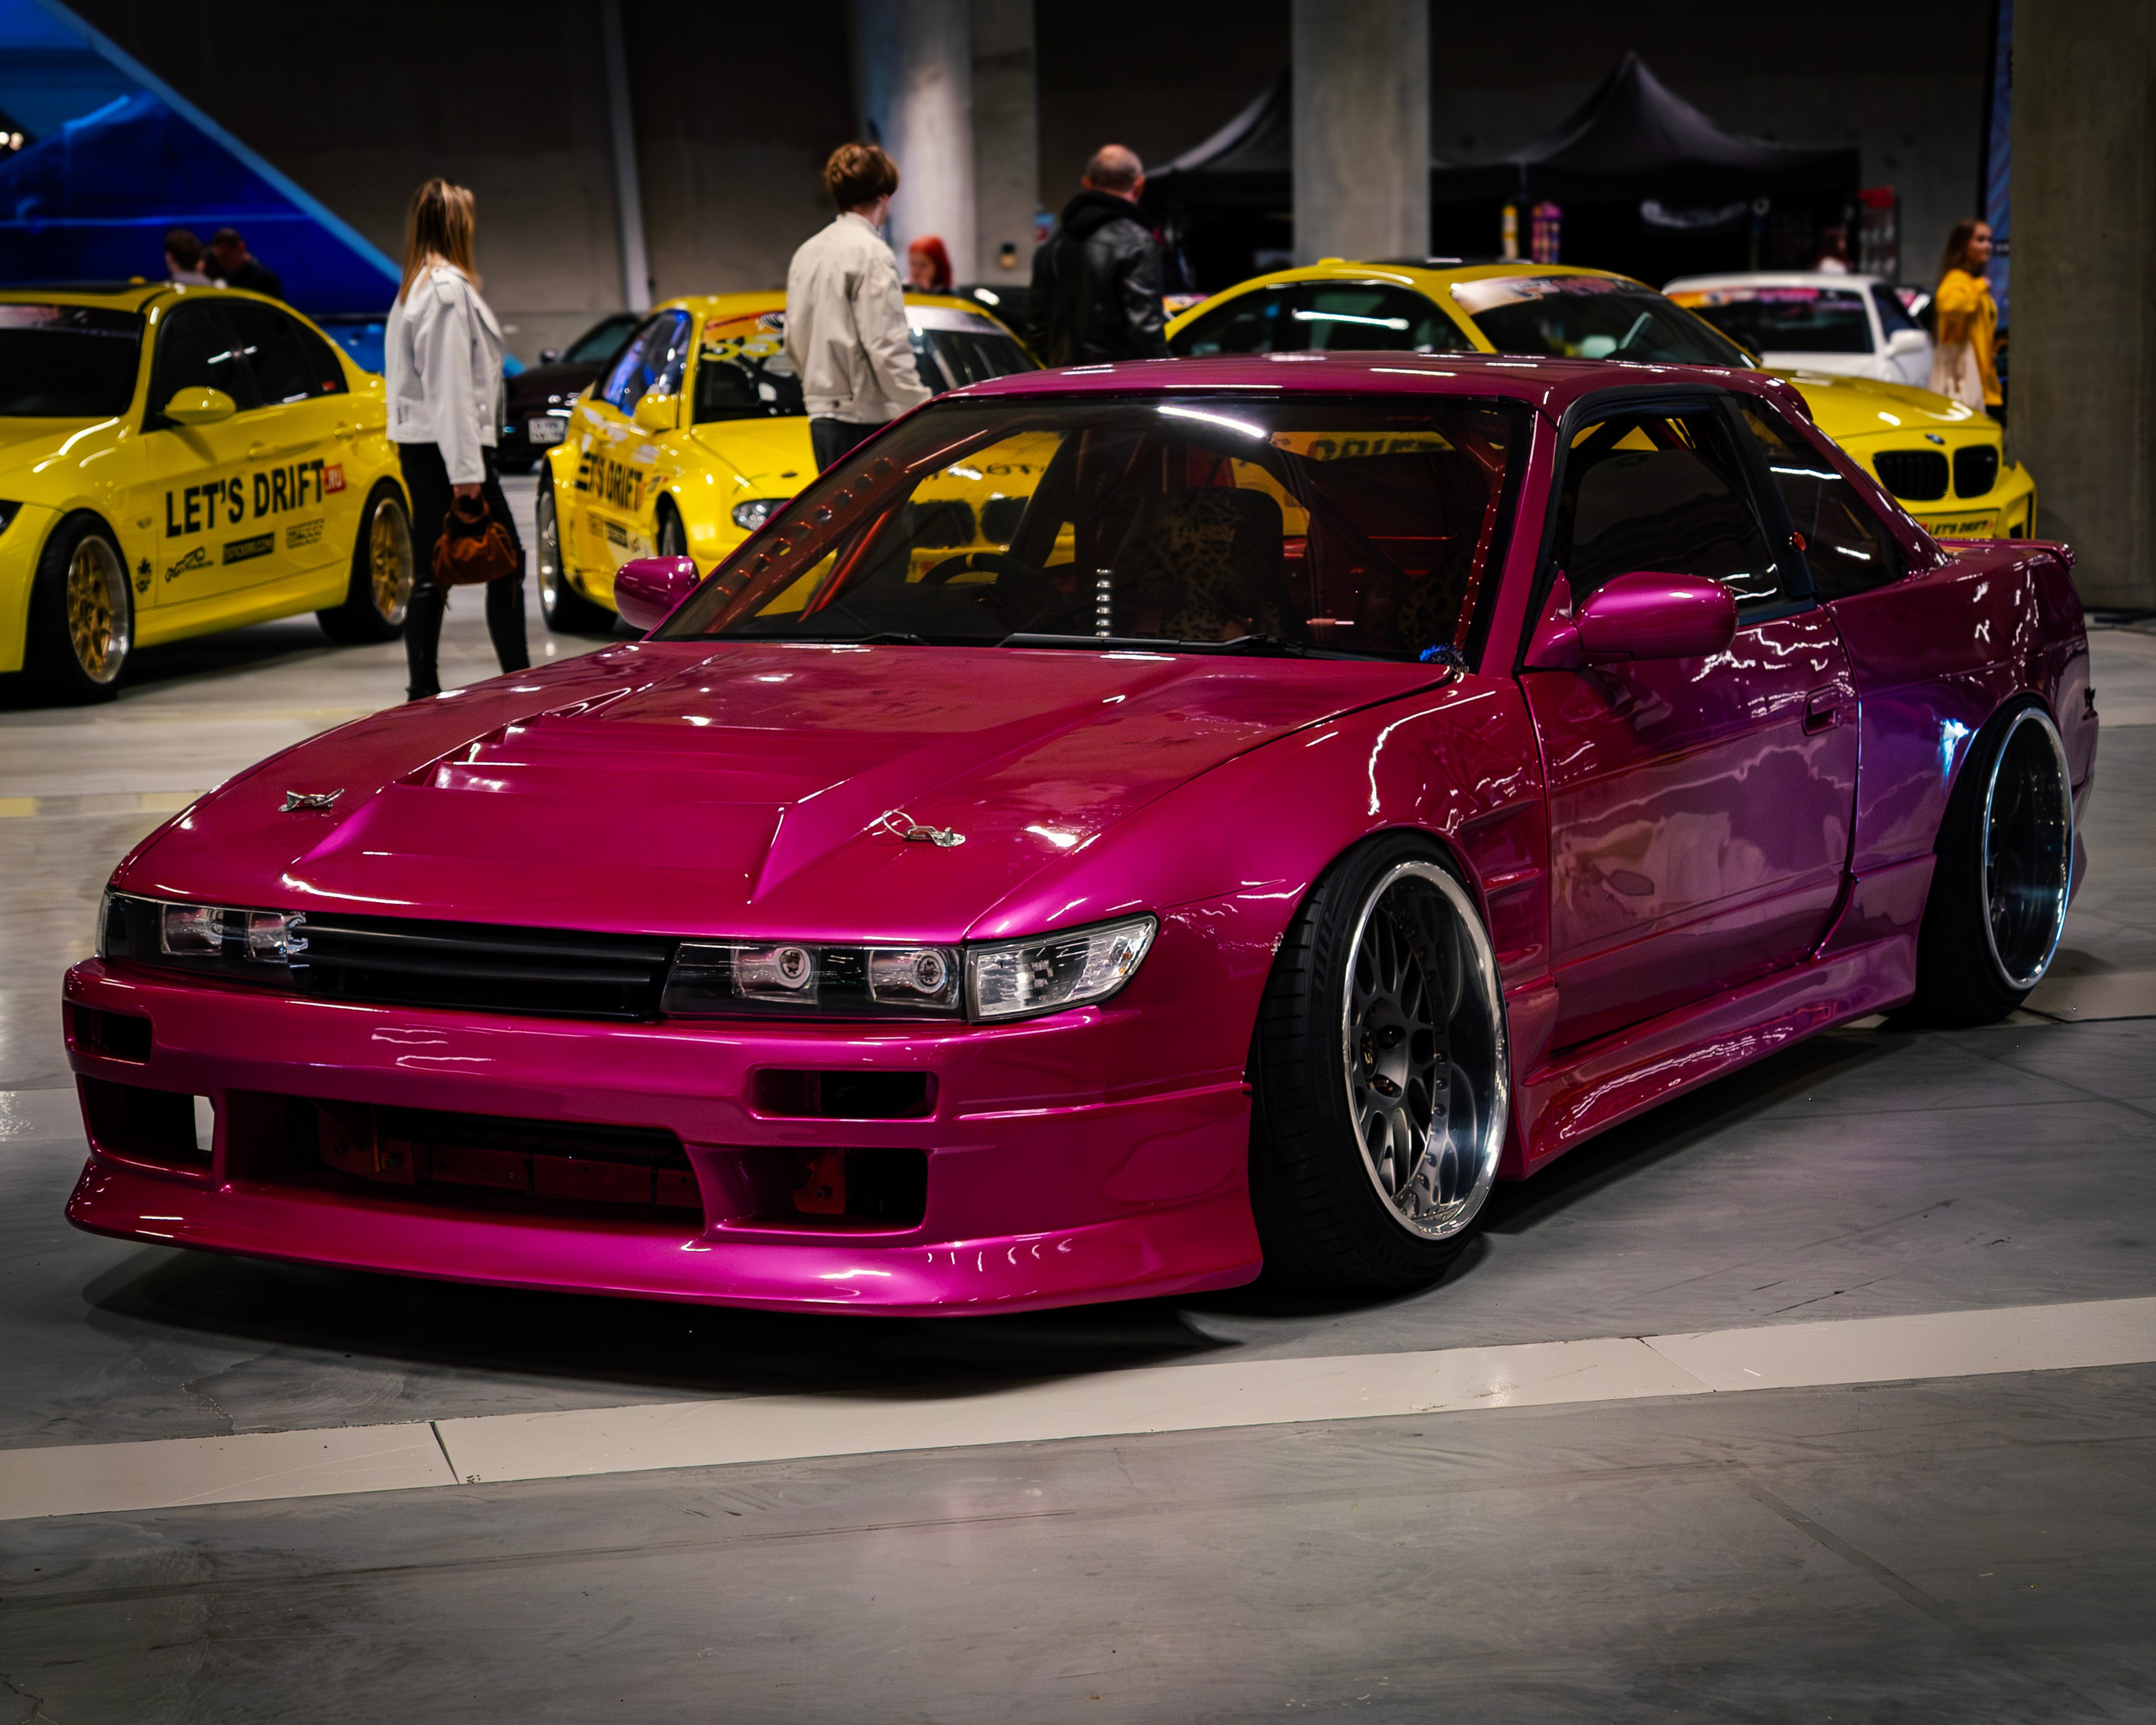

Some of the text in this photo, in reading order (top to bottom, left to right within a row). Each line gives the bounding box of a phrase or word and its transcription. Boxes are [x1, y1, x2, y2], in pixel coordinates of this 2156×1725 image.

[165, 477, 244, 538] LET'S
[253, 457, 324, 519] DRIFT
[606, 460, 643, 512] DRIFT
